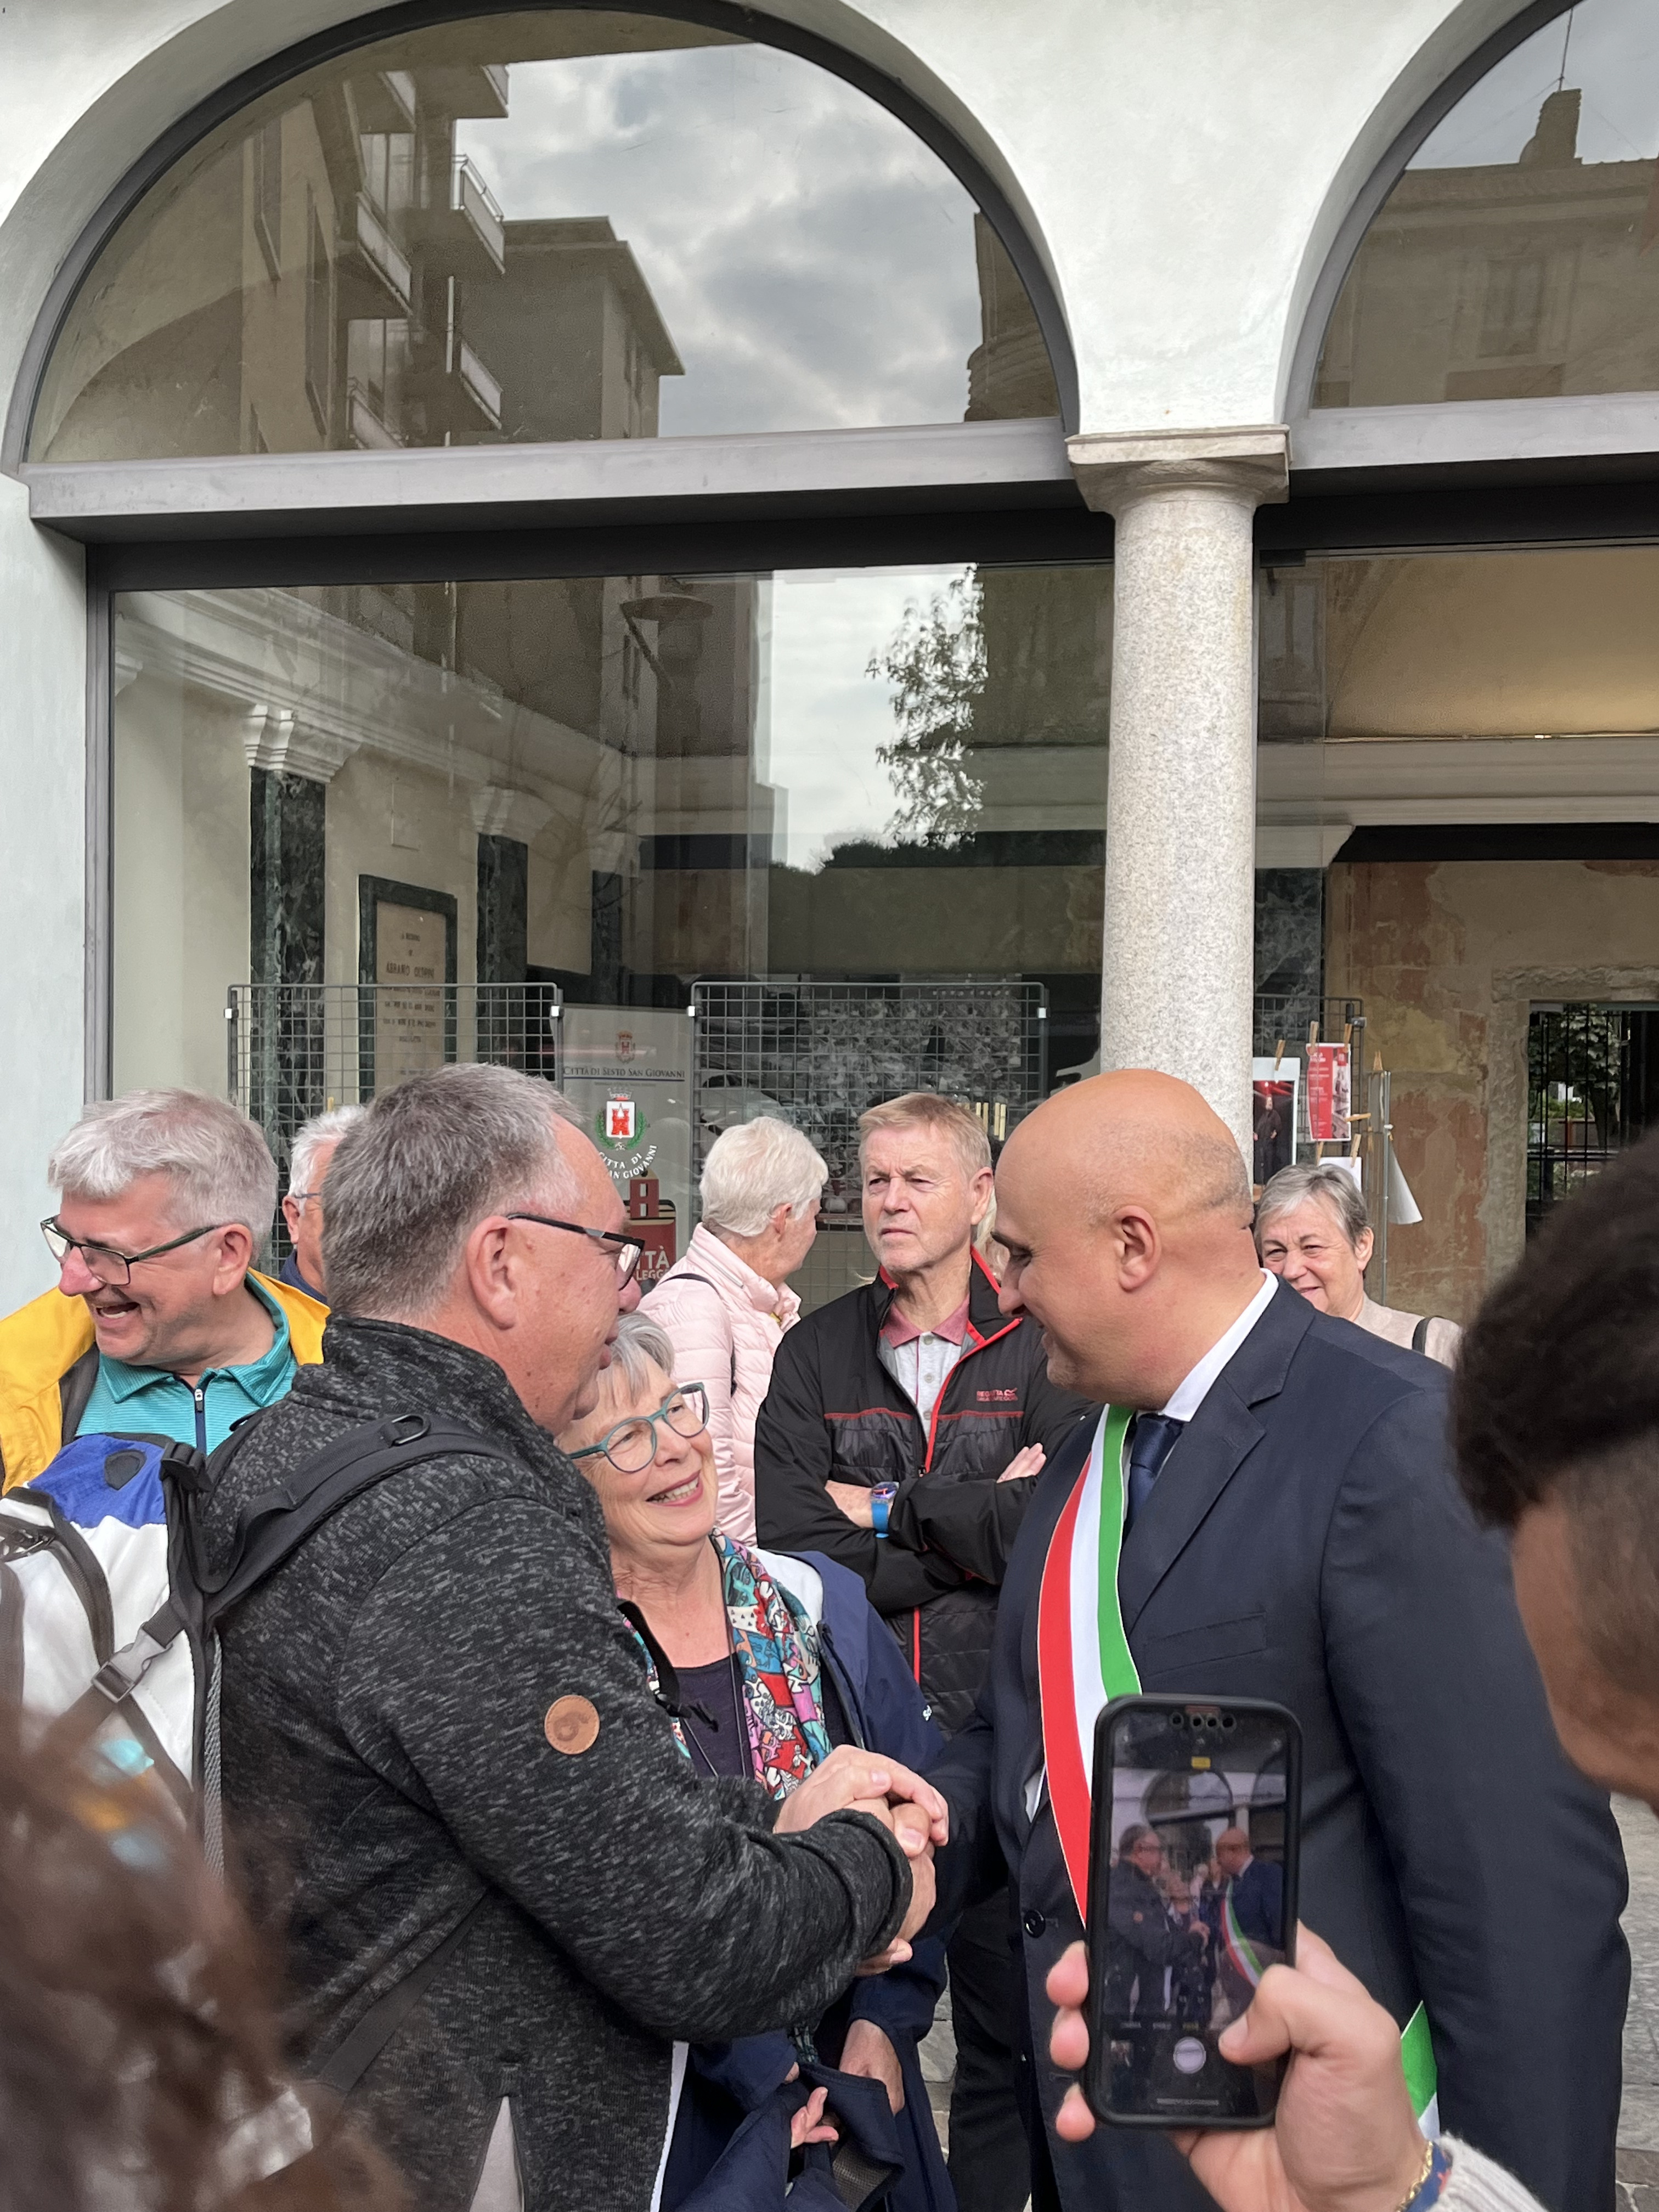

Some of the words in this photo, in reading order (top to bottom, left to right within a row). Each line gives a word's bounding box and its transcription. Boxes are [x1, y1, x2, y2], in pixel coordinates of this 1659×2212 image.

[590, 1067, 600, 1075] DI
[603, 1067, 626, 1076] SESTO
[629, 1068, 642, 1077] SAN
[646, 1068, 685, 1078] GIOVANNI
[623, 1145, 657, 1179] GIOVANNI
[631, 1153, 642, 1165] DI
